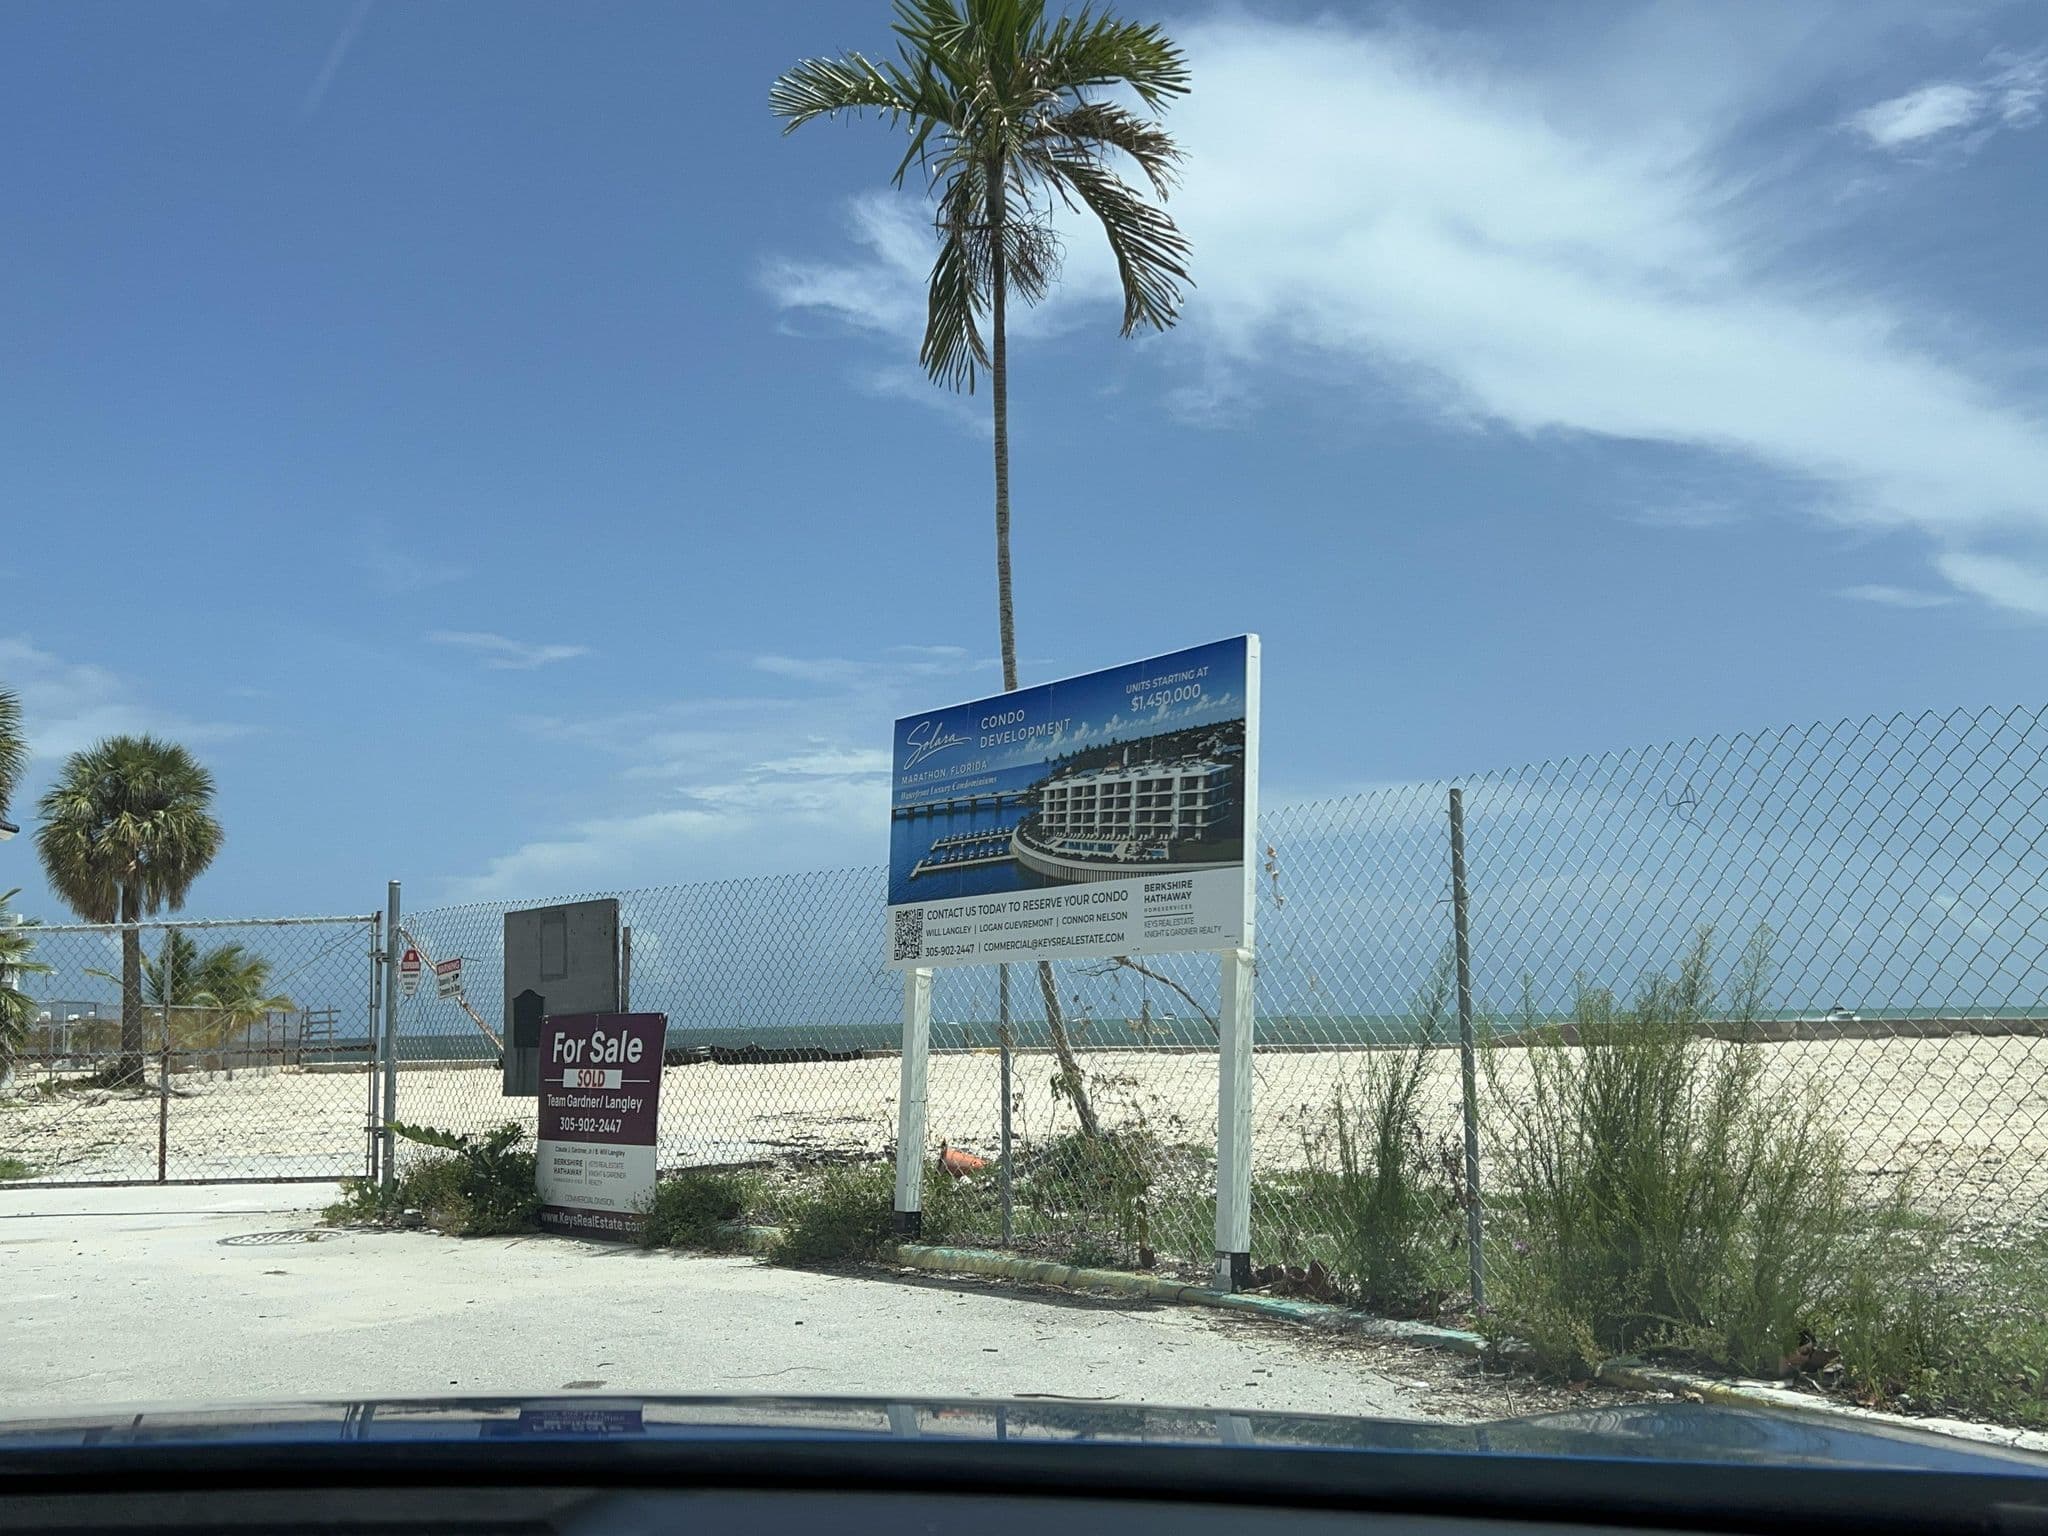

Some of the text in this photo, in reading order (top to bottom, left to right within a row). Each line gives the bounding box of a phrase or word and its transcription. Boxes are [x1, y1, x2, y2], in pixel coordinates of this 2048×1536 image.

[1126, 666, 1208, 694] UNITS STARTING AT
[1130, 684, 1200, 712] $1,450,000
[981, 709, 1025, 730] CONDO
[980, 718, 1071, 749] DEVELOPMENT
[951, 760, 987, 776] FLORIDA
[1144, 879, 1193, 893] BERKSHIRE
[927, 890, 1129, 921] CONTACT US TODAY TO RESERVE YOUR CONDO
[1144, 891, 1192, 903] HATHAWAY
[926, 911, 1128, 937] WILL LANGLEY LOGAN GUEVREMONT CONNOR NELSON
[1173, 917, 1194, 926] ESTATE
[925, 932, 1125, 957] 305-902-2447 COMMERCIAL@KEYSREALESTATE.COM
[552, 1029, 643, 1064] For Sale
[576, 1069, 605, 1087] SOLD
[547, 1094, 566, 1107] Team
[605, 1095, 643, 1113] Langley
[560, 1117, 622, 1133] 305-902-2447
[553, 1157, 583, 1167] BERKSHIRE
[553, 1167, 582, 1176] HATHAWAY
